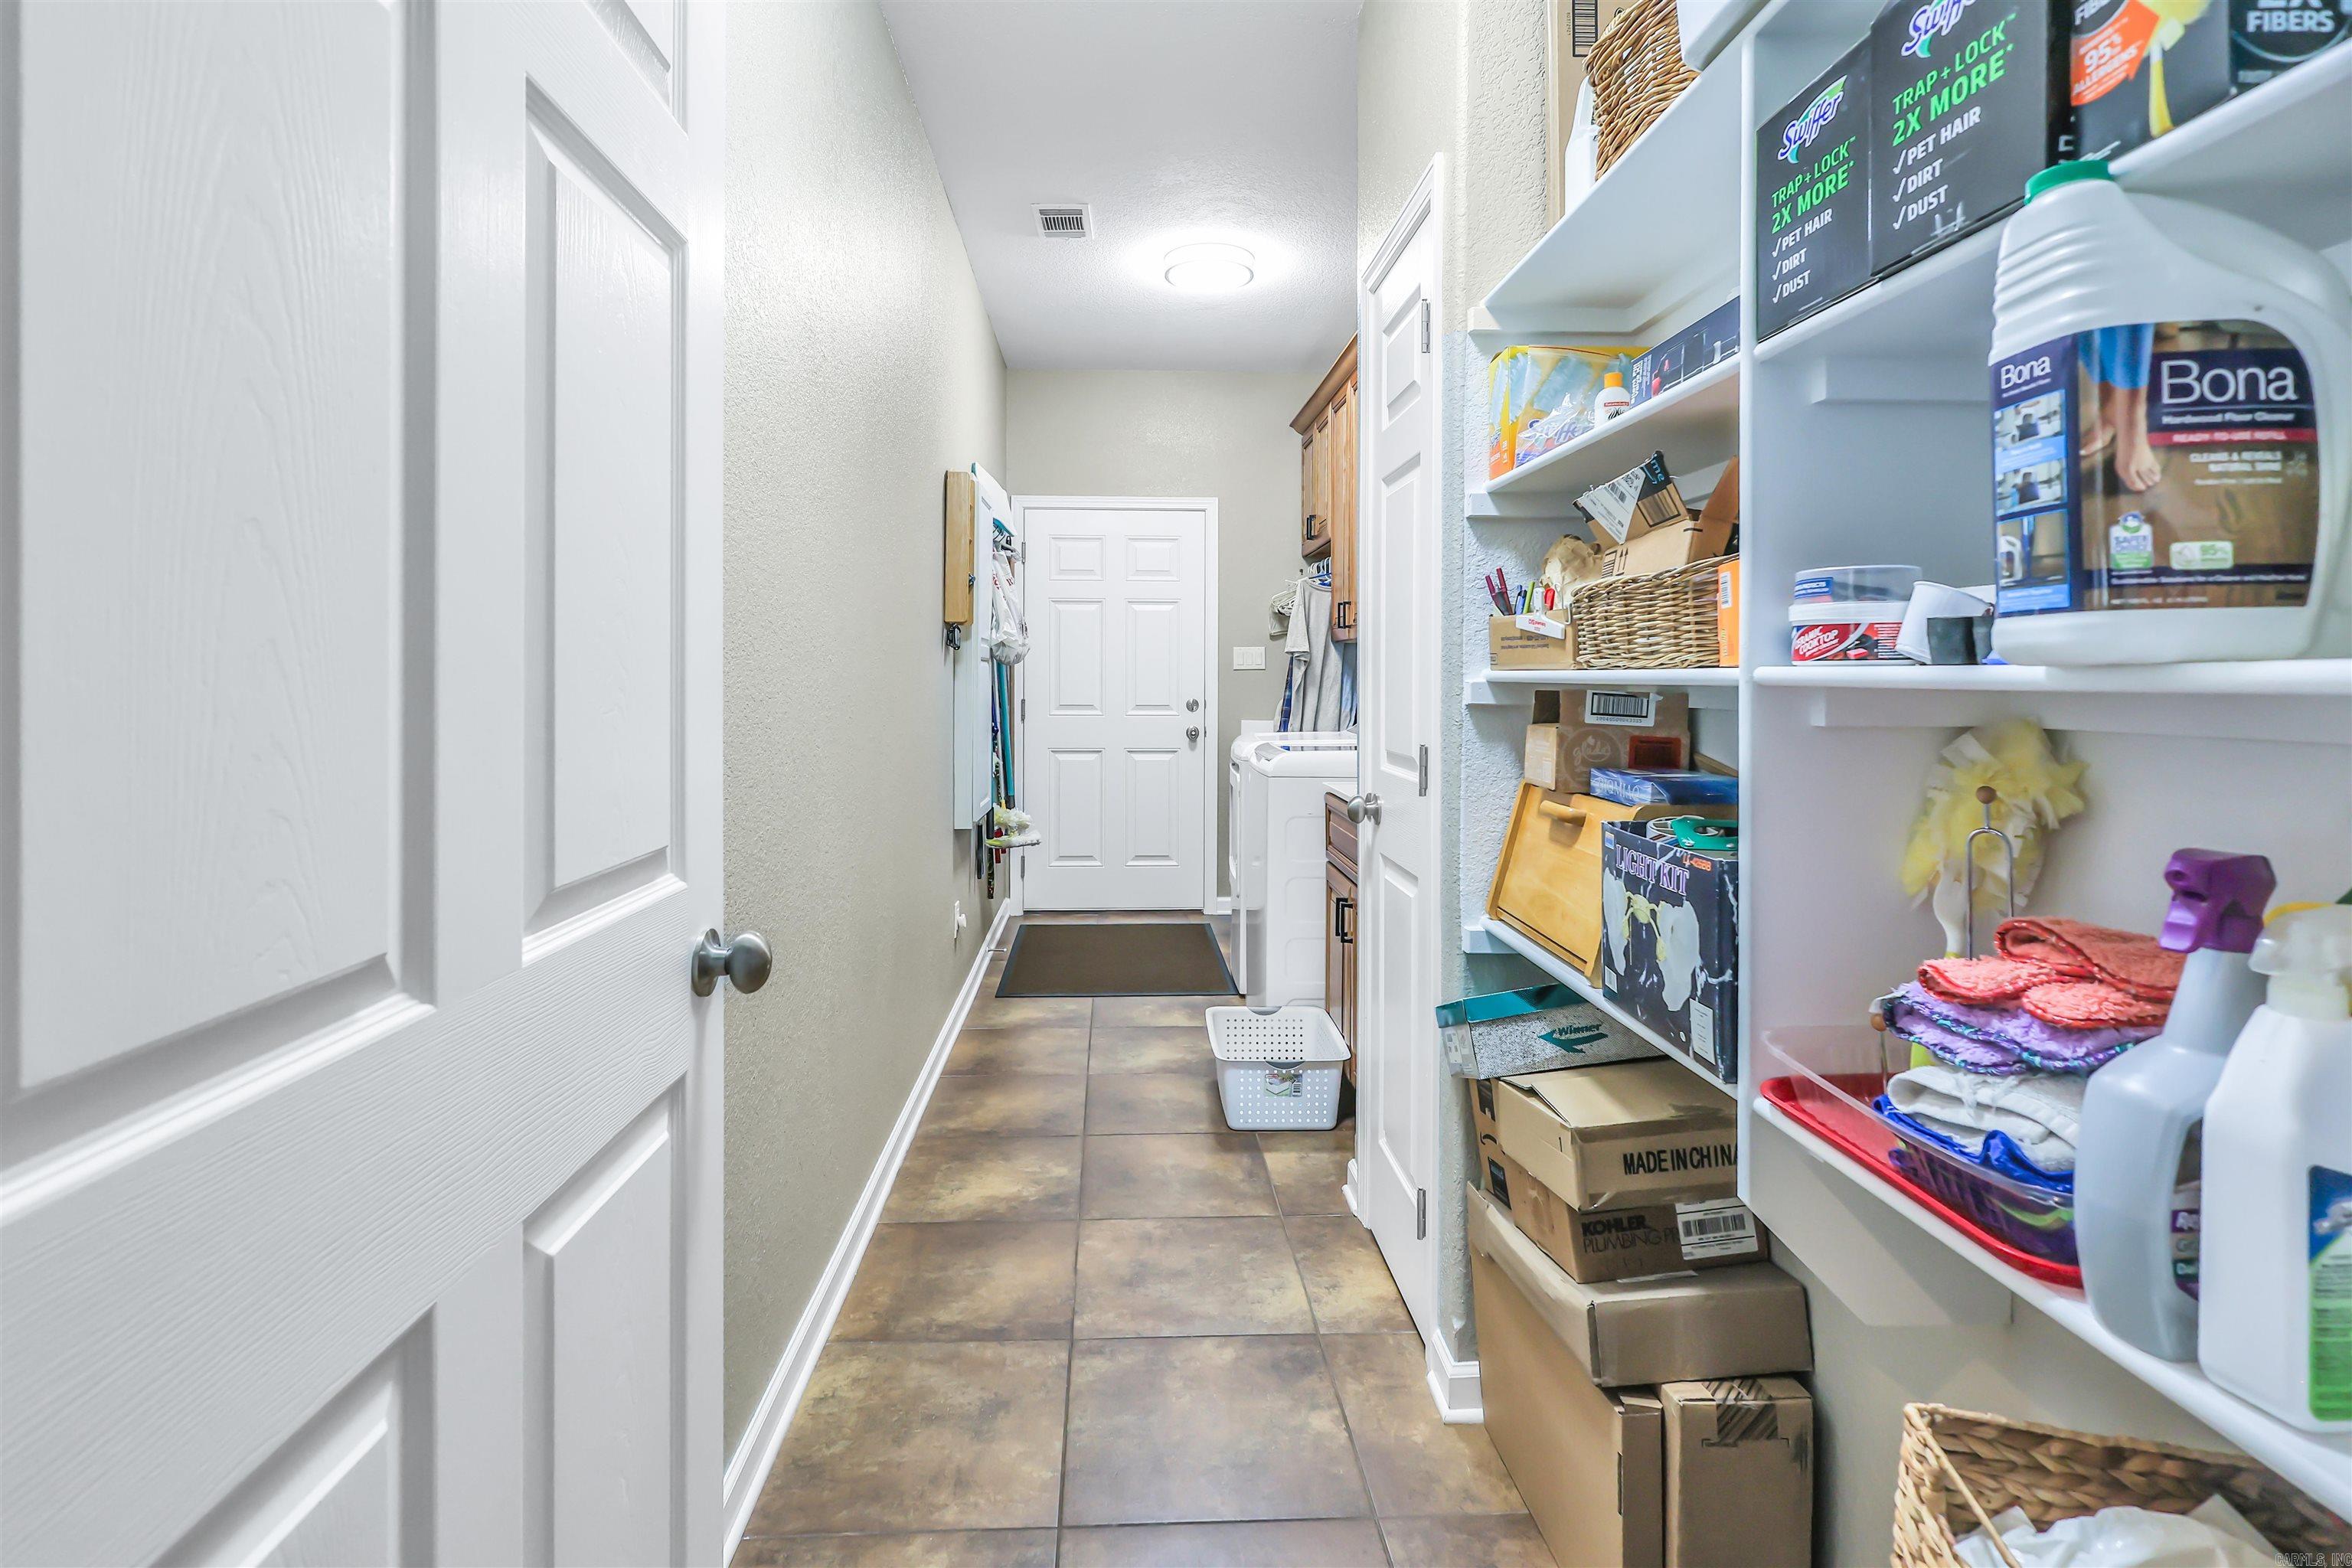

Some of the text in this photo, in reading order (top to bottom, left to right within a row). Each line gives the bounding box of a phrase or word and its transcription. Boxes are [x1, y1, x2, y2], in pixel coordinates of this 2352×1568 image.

[2246, 10, 2334, 32] FIBERS
[1778, 91, 1844, 161] Swiffer
[1893, 106, 1922, 147] 2X
[1907, 106, 1981, 165] PET HAIR
[1907, 158, 1943, 194] DIRT
[1772, 202, 1792, 234] 2X
[1907, 185, 1949, 222] DUST
[1782, 208, 1833, 250] PET HAIR
[1782, 248, 1807, 274] DIRT
[1782, 270, 1811, 297] DUST
[2001, 356, 2051, 389] Bona
[2161, 359, 2298, 404] Bona
[1799, 629, 1838, 655] COOKTOP
[1615, 844, 1690, 896] LIGHT KIT
[1623, 1150, 1668, 1175] MADE
[1670, 1148, 1687, 1171] IN
[1582, 1215, 1648, 1236] KOHLER
[1583, 1229, 1661, 1253] PLUMBING
